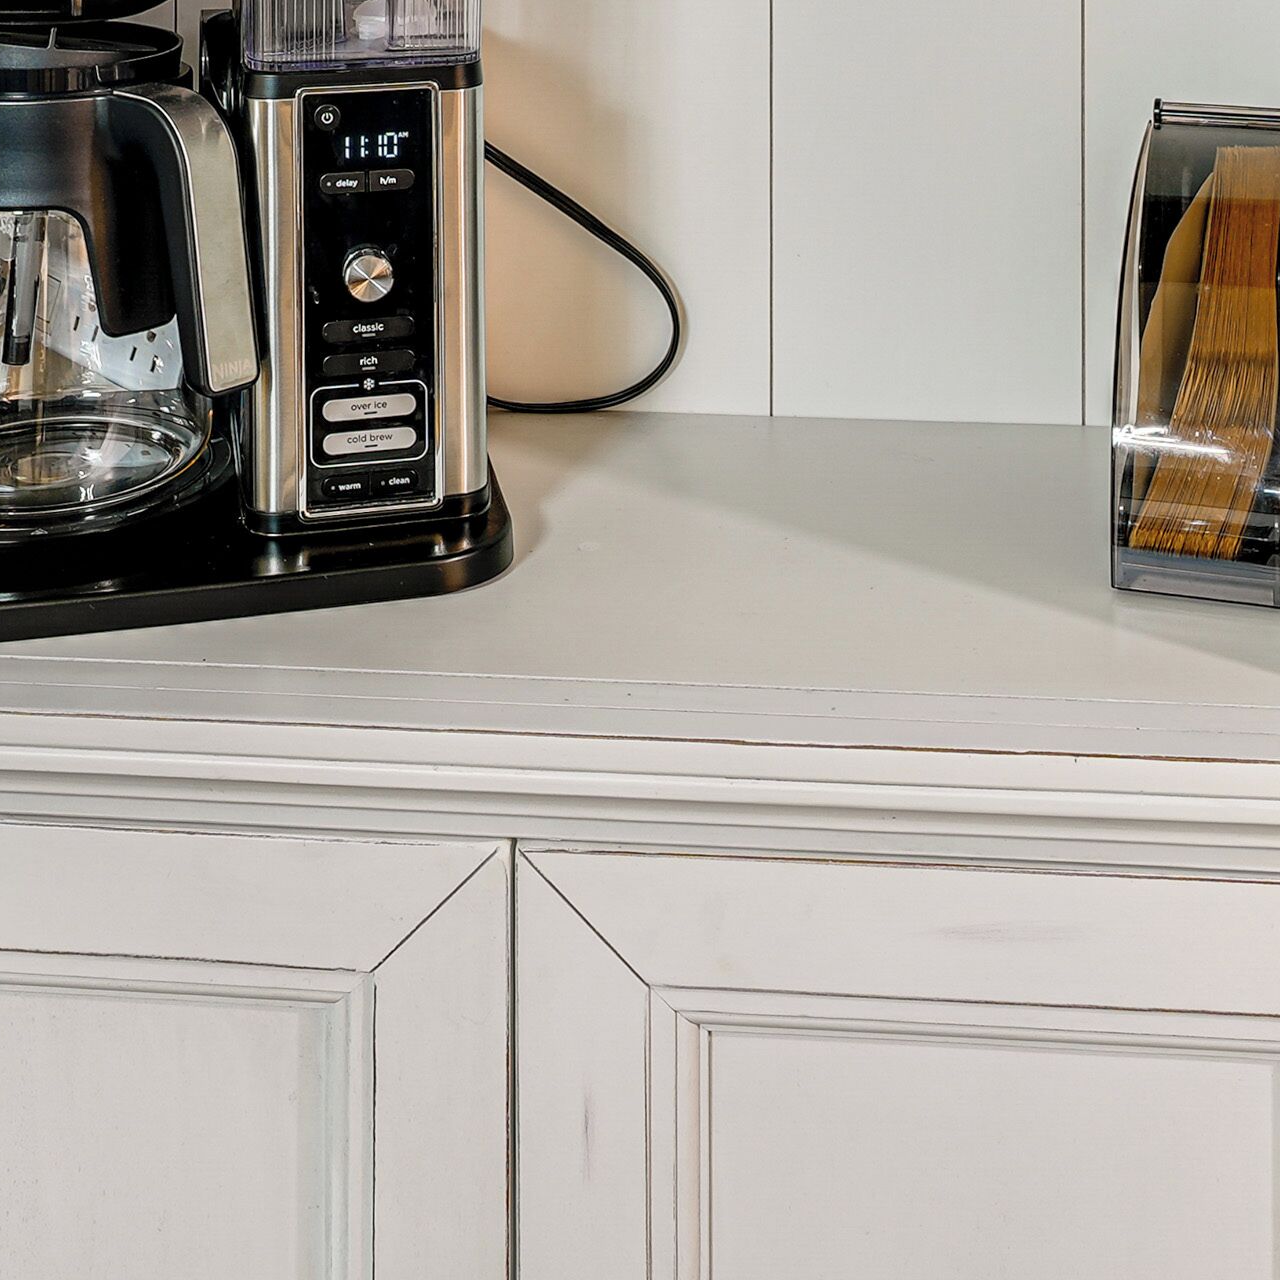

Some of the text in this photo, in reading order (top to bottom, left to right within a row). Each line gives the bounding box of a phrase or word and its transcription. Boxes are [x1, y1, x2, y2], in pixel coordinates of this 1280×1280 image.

[345, 132, 398, 159] 11:10
[336, 178, 358, 188] delay
[379, 176, 397, 185] h/m
[352, 322, 385, 333] classic
[359, 356, 378, 366] rich
[351, 400, 387, 411] over ice
[347, 433, 393, 444] cold brew
[388, 476, 410, 486] clean
[338, 482, 361, 491] warm
